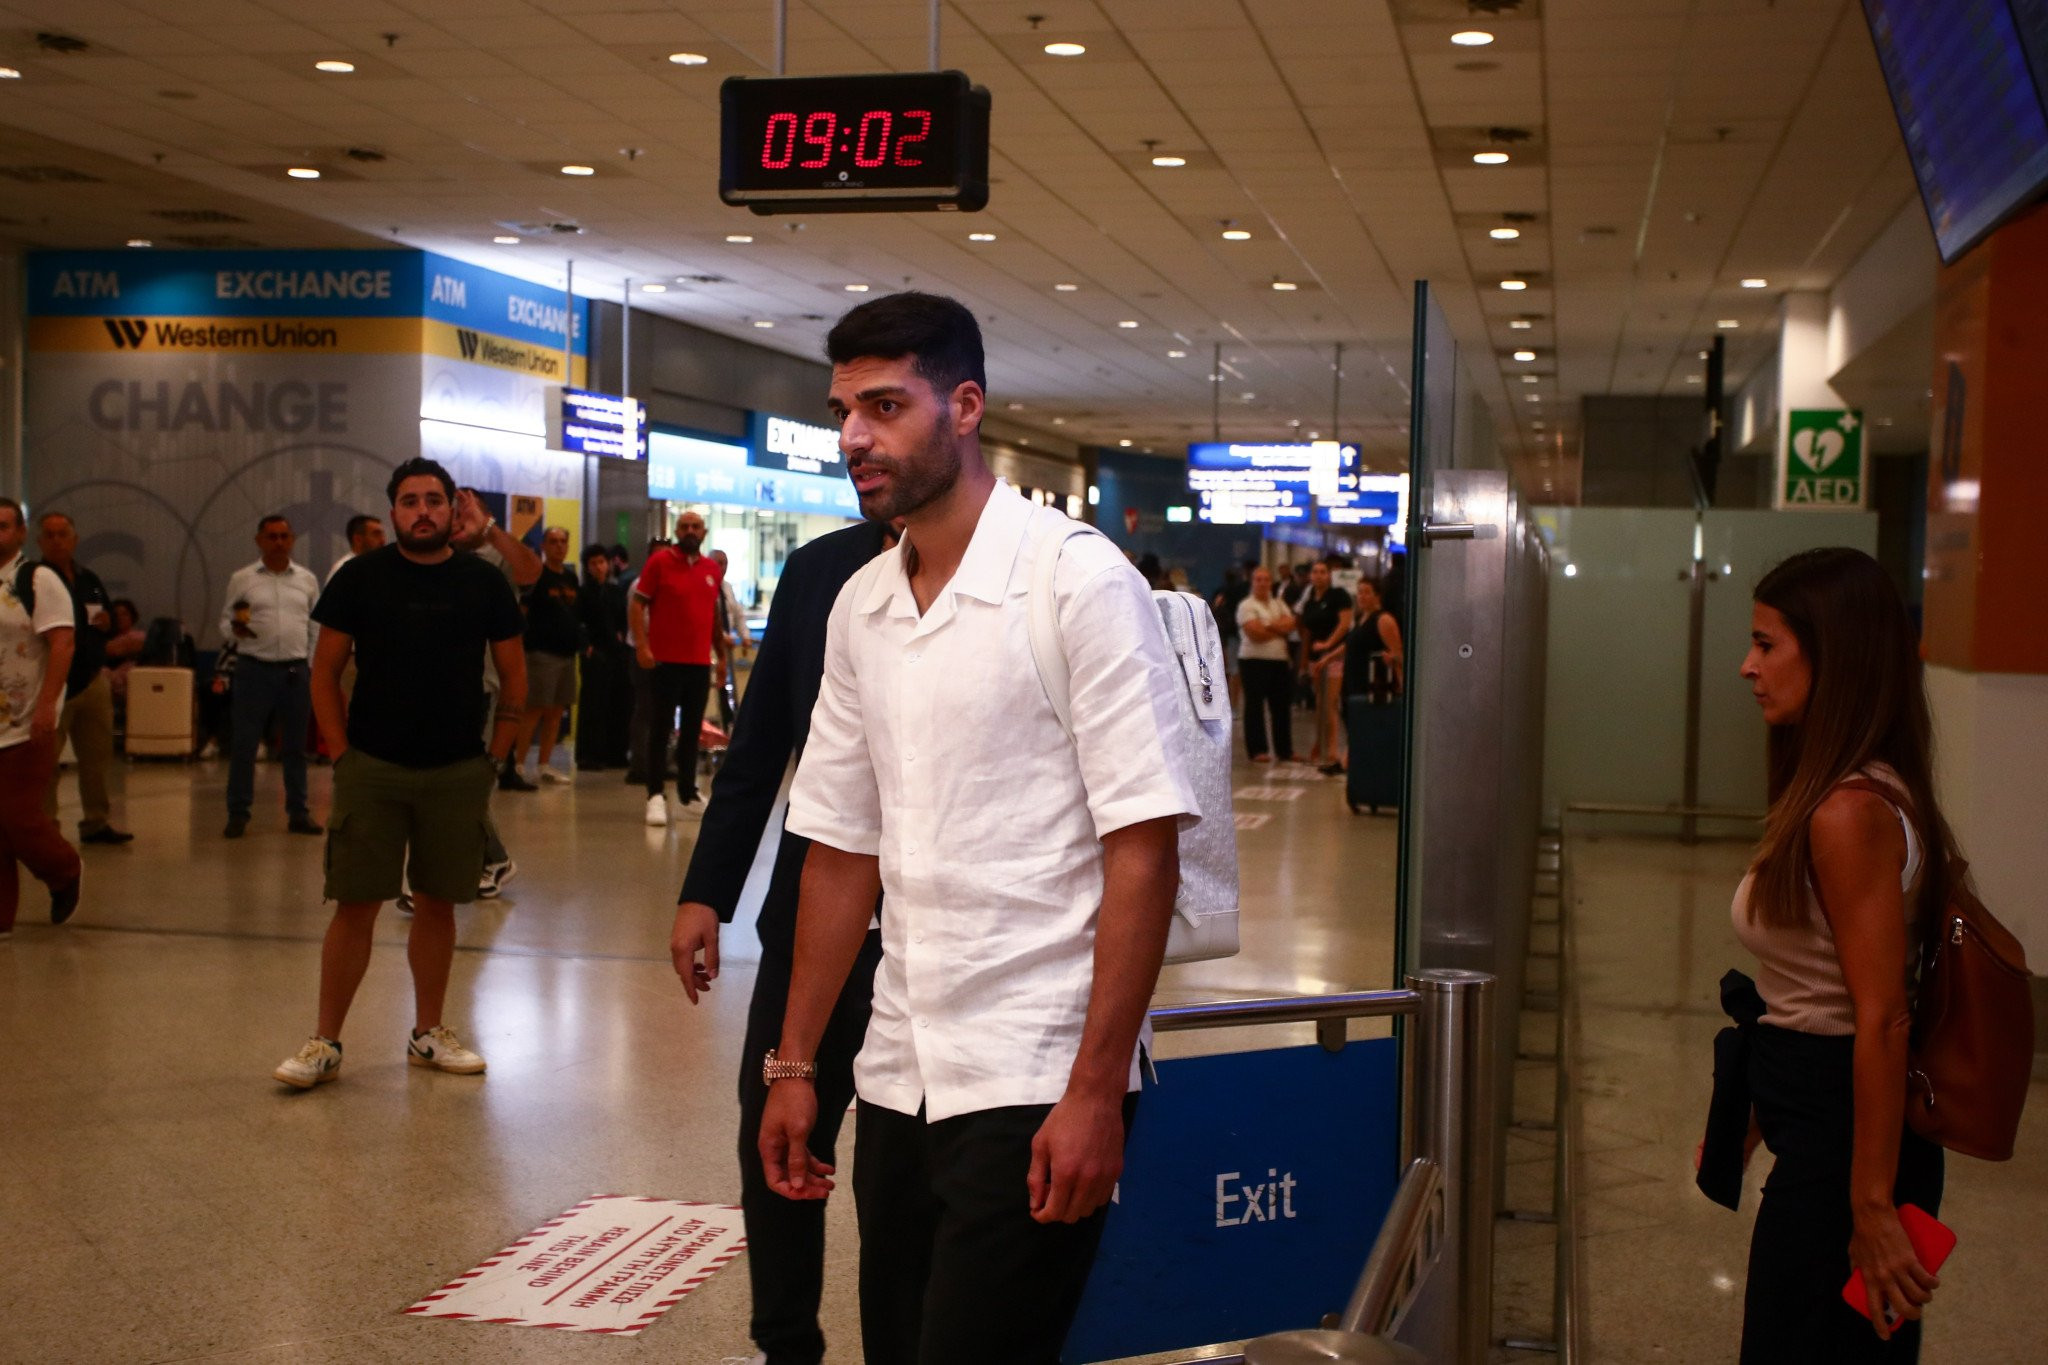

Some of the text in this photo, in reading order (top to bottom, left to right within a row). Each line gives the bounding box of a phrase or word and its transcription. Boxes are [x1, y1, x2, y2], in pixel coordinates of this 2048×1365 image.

[761, 110, 932, 169] 09:02
[53, 270, 391, 299] ATM EXCHANGE
[431, 274, 581, 338] ATM EXCHANE
[154, 322, 338, 348] Western Union
[481, 338, 560, 375] Western Union
[88, 379, 350, 433] CHANGE
[1791, 478, 1854, 503] AED
[1215, 1168, 1297, 1228] Exit
[516, 1235, 589, 1272] THIS LINE
[527, 1226, 631, 1288] REMAIN BEHIND
[569, 1218, 706, 1309] ΑΠΟ ΑΥΤΗ ΤΗ ΓΡΑΜΜΗ
[610, 1226, 728, 1304] ΠΑΡΑΜΕΙΝΕΤΕ ΠΙΣΩ
